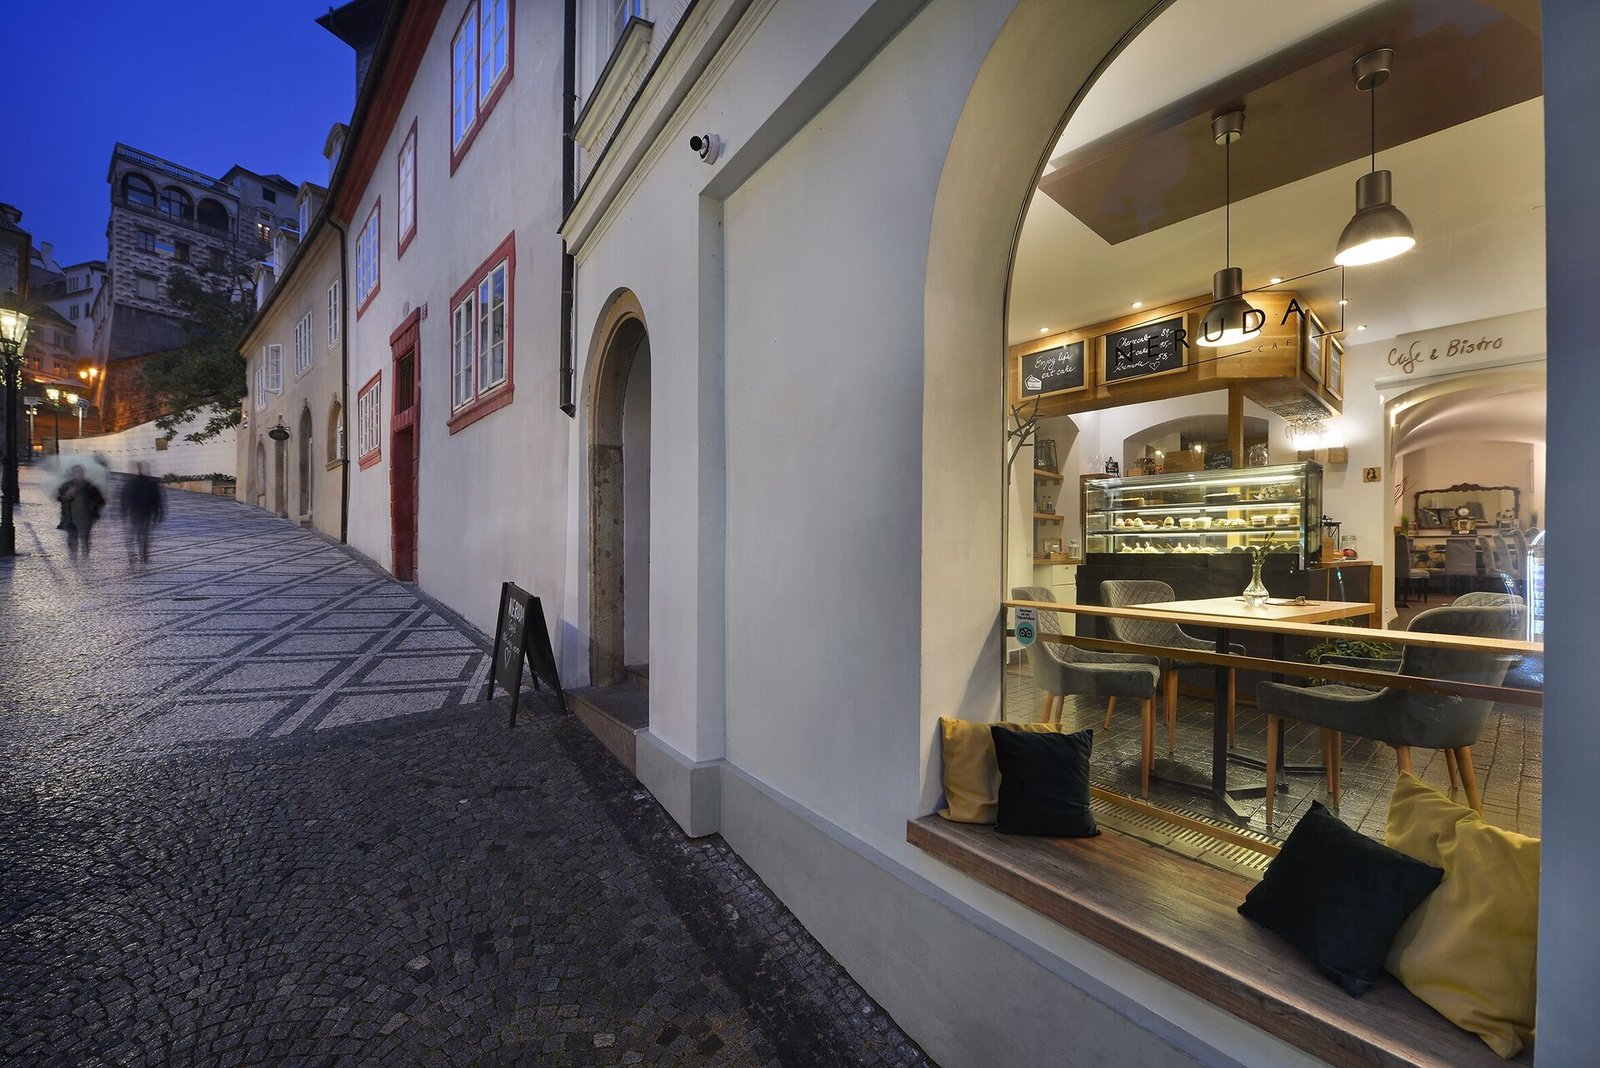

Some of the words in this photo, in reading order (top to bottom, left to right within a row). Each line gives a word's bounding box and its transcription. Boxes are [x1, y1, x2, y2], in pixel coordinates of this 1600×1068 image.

[1115, 298, 1306, 367] NERUDA
[1447, 337, 1503, 357] Bistro
[1034, 355, 1056, 371] Enjoy
[1058, 351, 1073, 364] life
[1041, 370, 1055, 379] eat
[1057, 365, 1076, 376] cake
